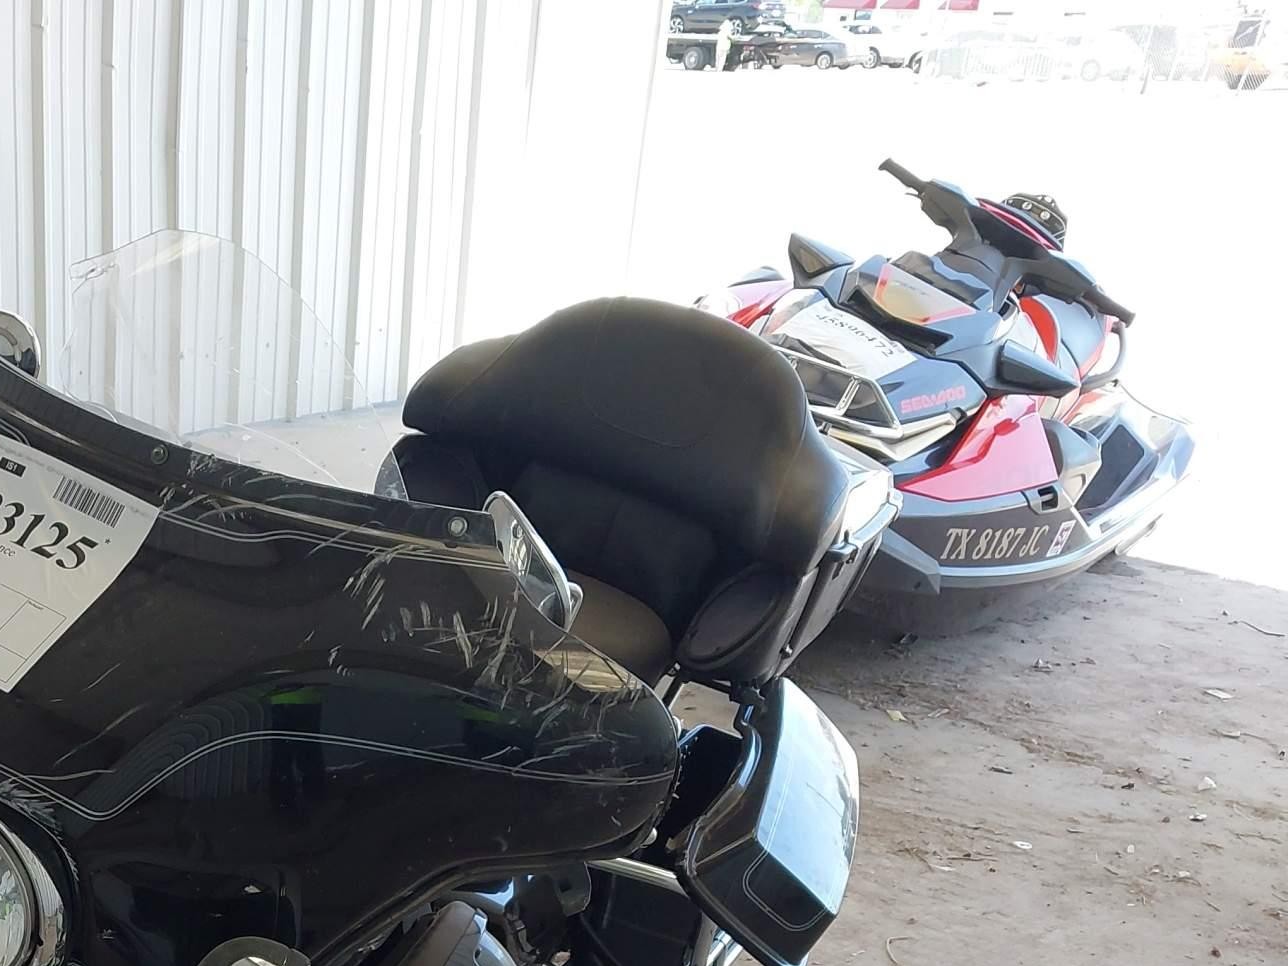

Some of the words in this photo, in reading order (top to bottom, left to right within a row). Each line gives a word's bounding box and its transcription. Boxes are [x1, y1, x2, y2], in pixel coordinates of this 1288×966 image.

[940, 527, 976, 559] TX
[972, 527, 1027, 560] 8187
[1019, 525, 1050, 557] JC
